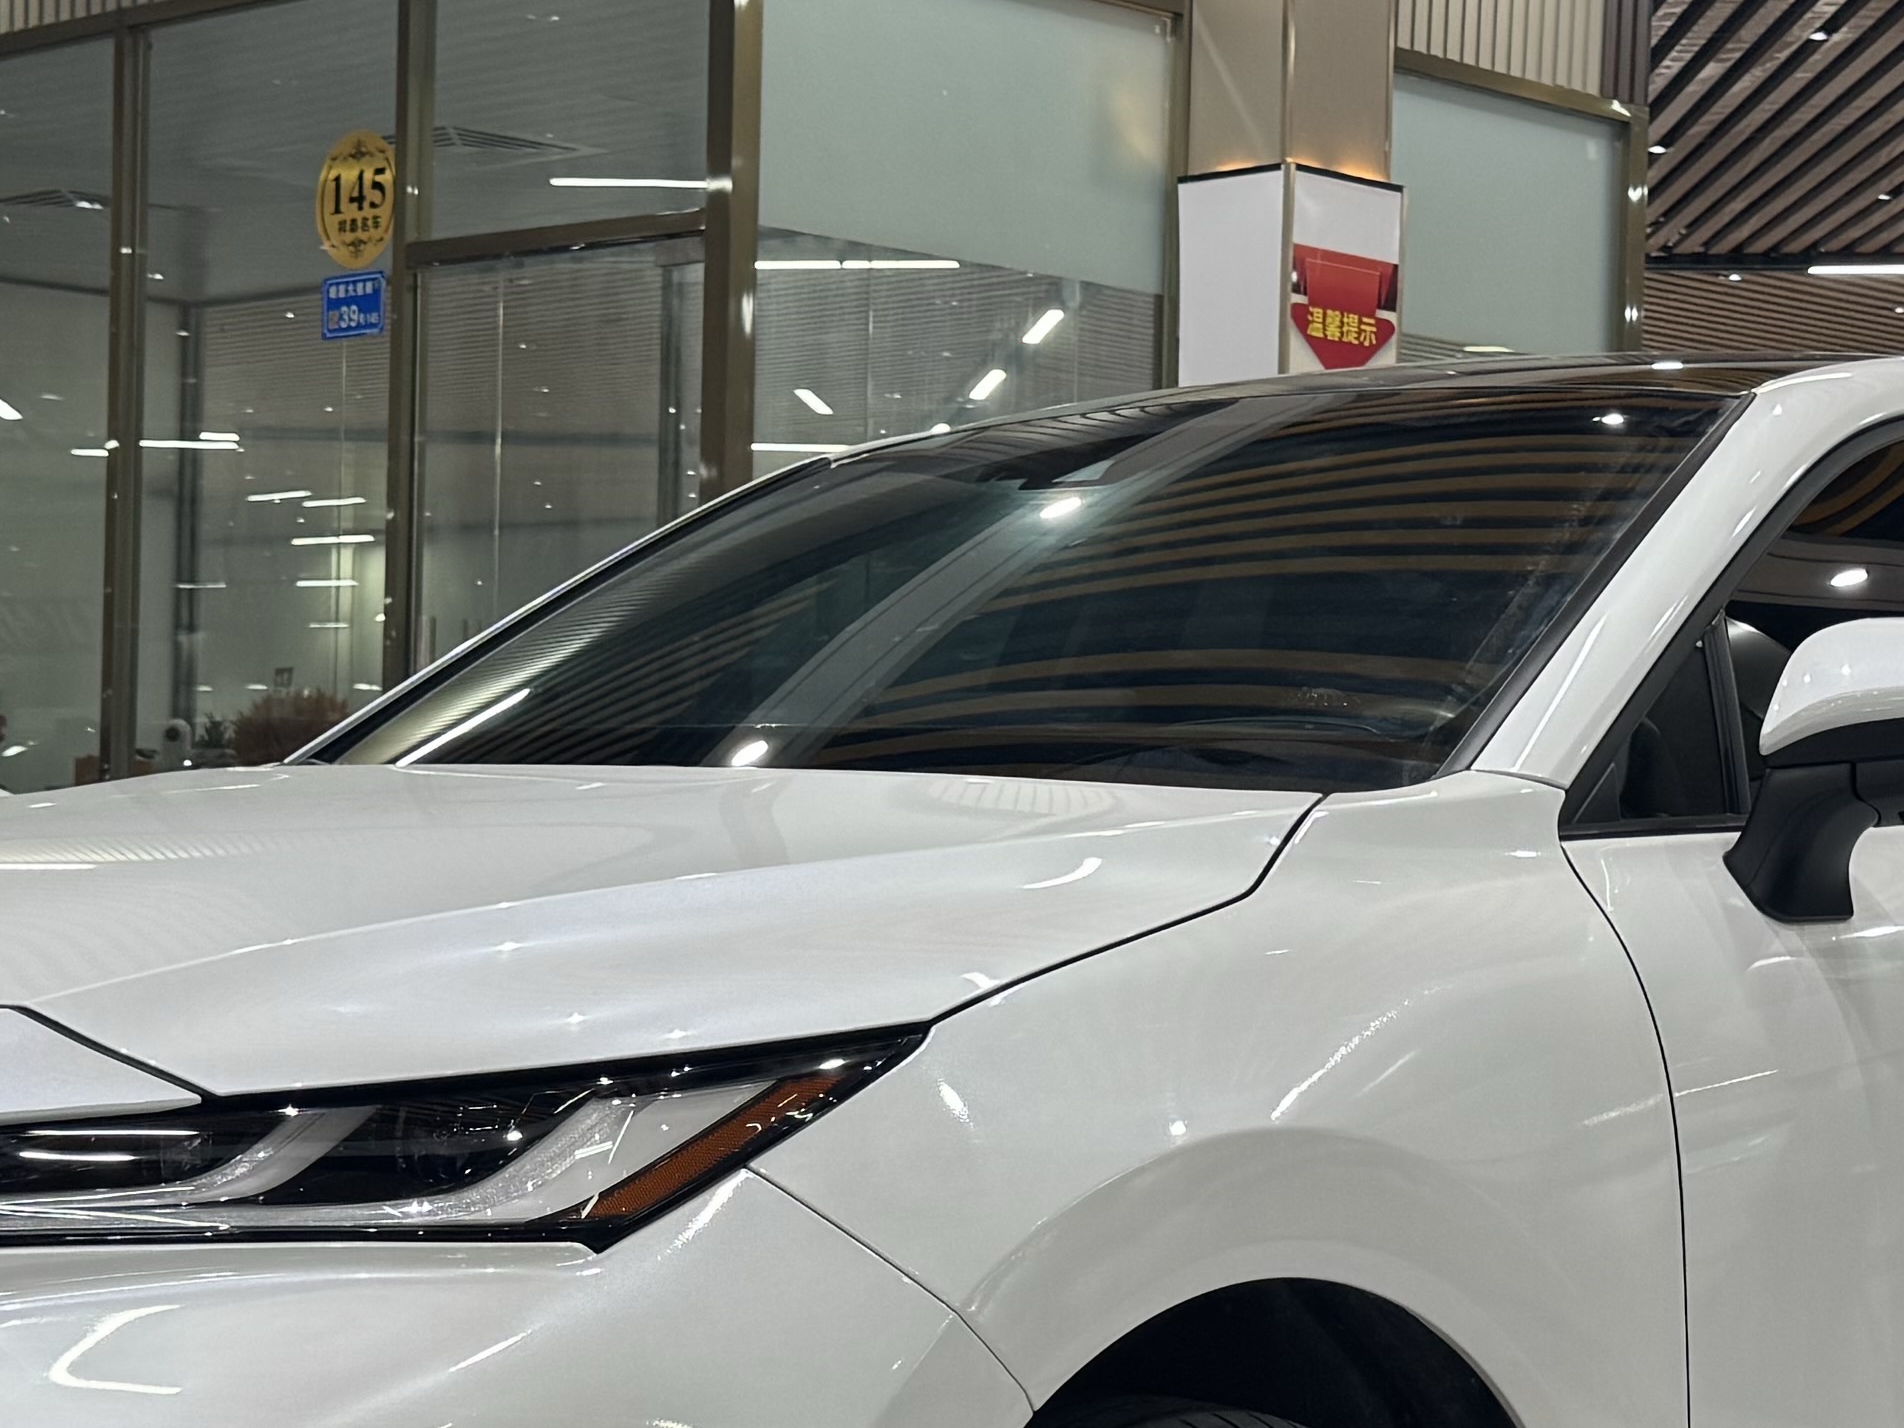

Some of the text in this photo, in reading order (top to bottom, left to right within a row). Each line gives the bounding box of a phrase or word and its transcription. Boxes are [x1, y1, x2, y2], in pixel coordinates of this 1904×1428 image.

[330, 167, 386, 215] 145
[1307, 306, 1377, 347] 温馨提示
